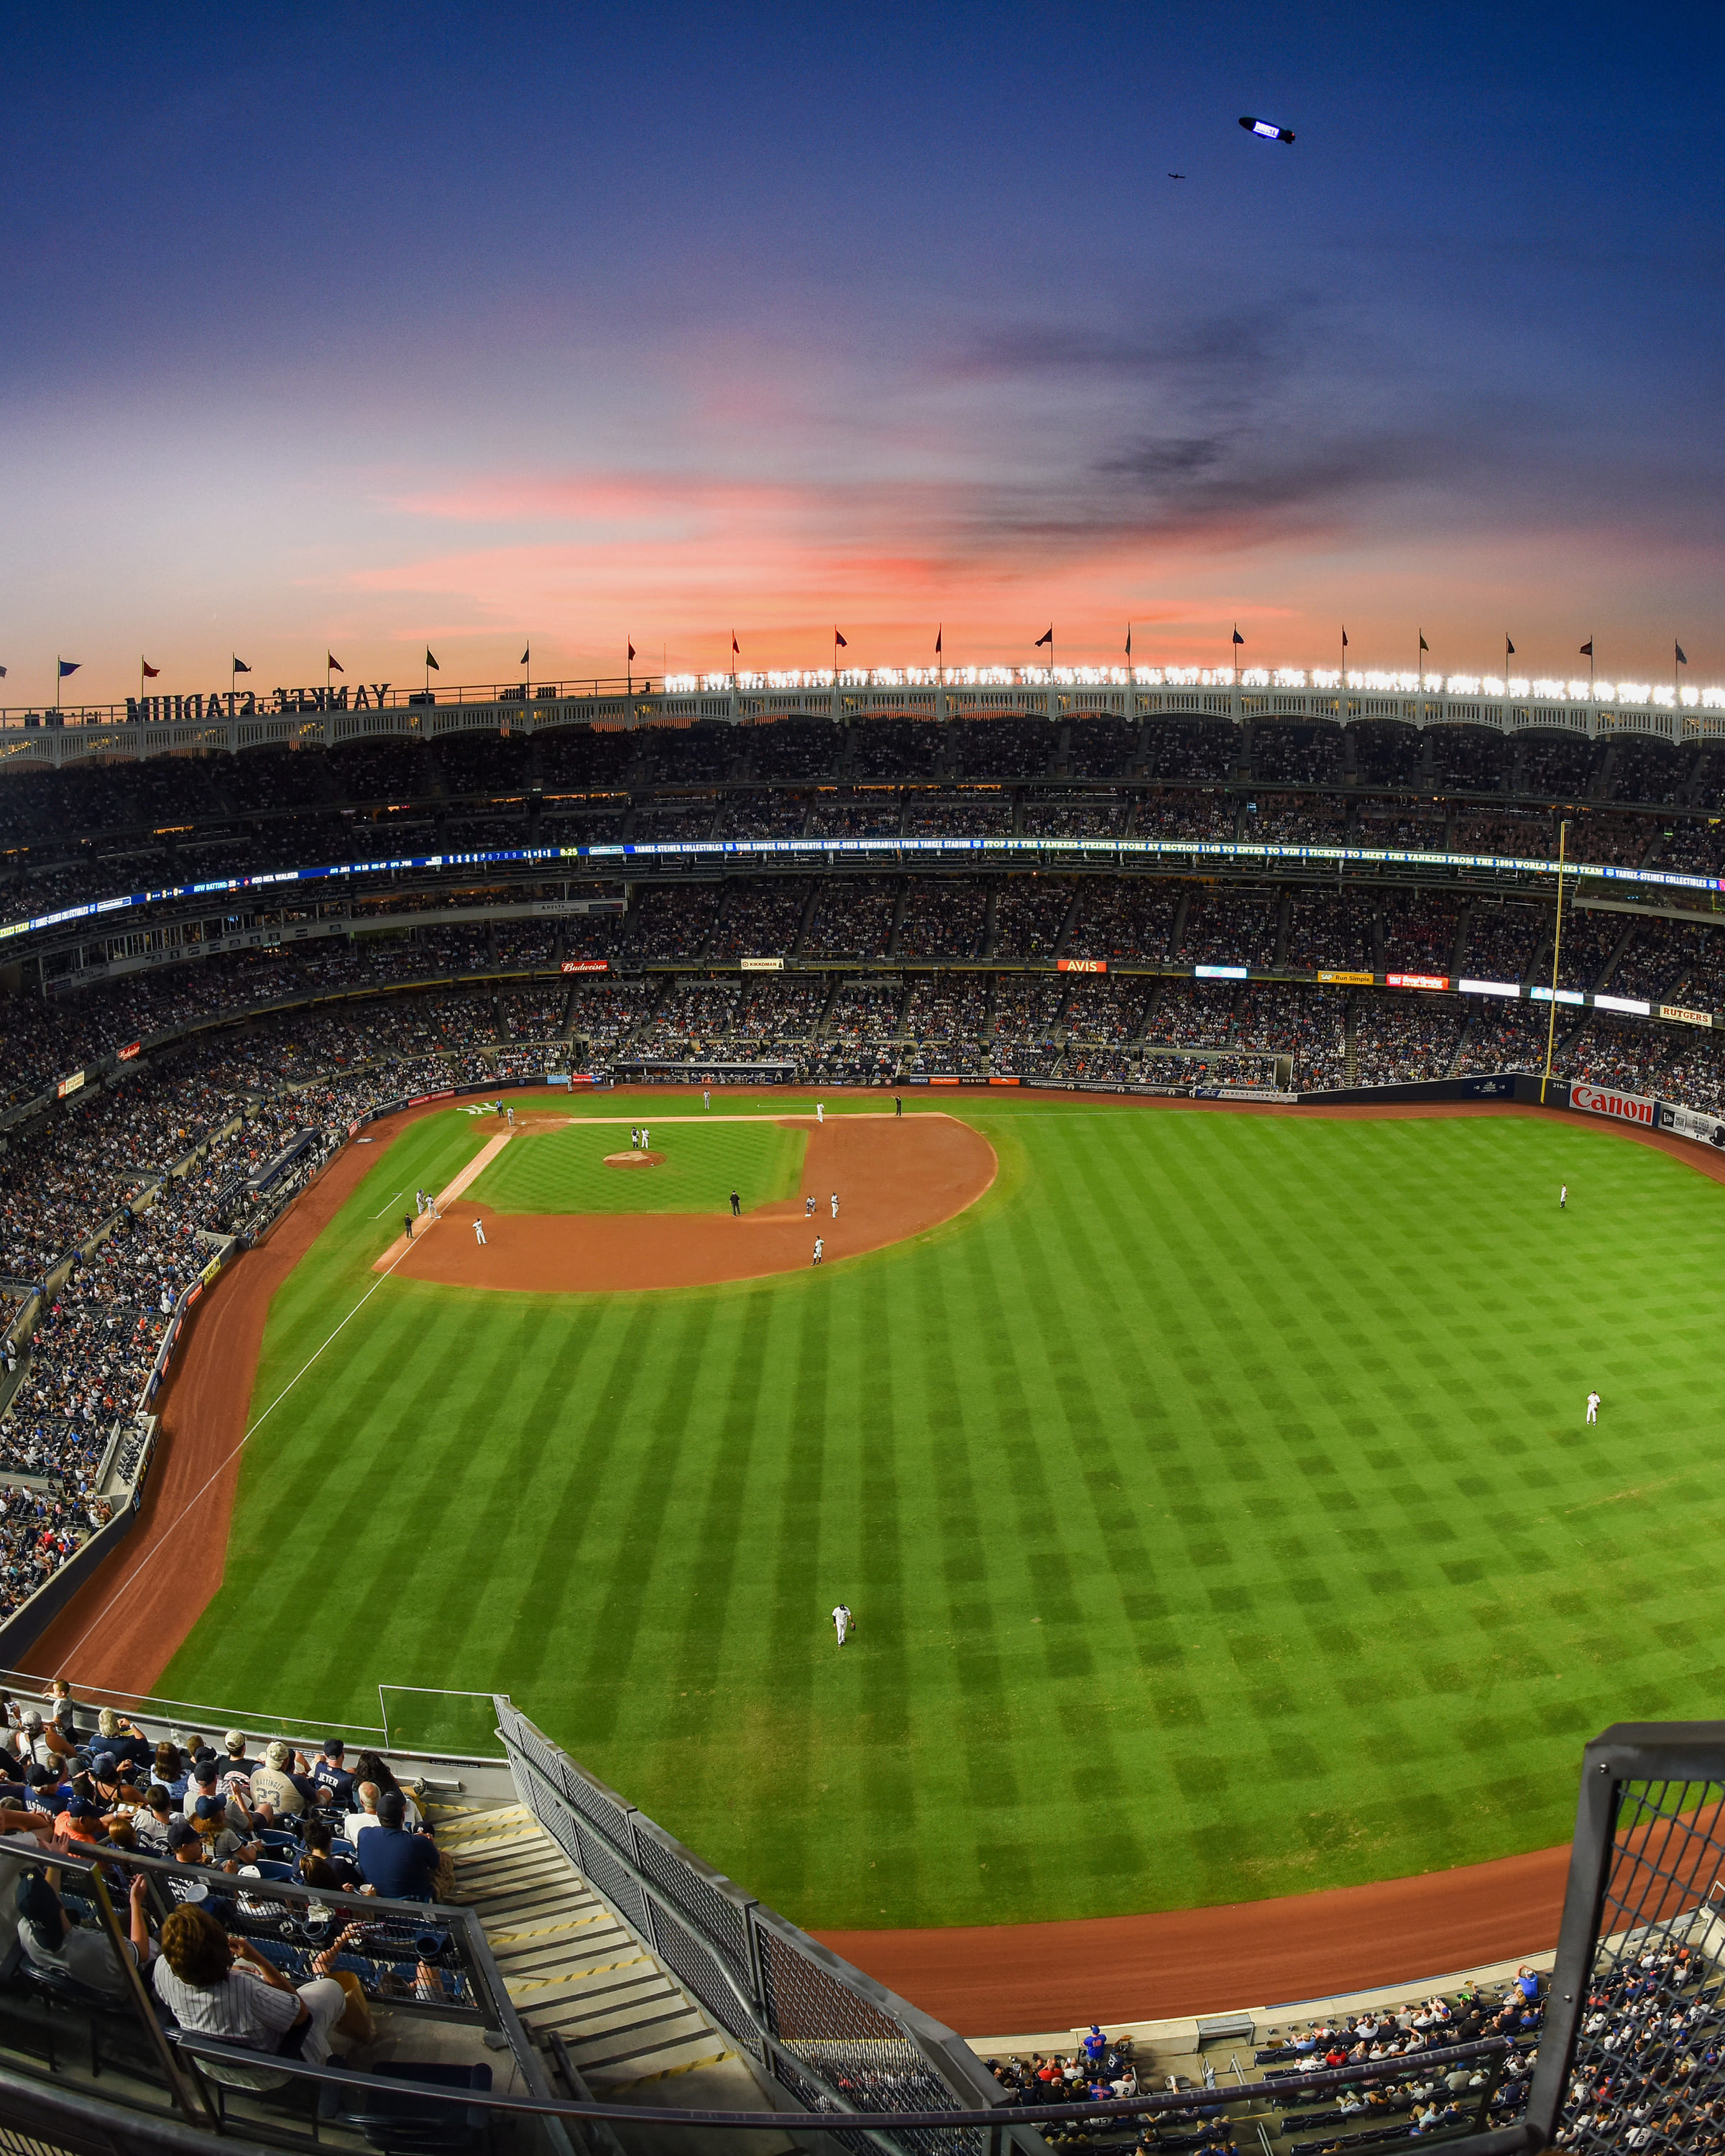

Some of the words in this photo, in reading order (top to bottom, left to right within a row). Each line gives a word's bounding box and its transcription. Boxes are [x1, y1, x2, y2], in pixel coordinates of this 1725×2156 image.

[634, 844, 681, 853] YANKEE-STEINER
[682, 843, 723, 852] COLLECTIBLES
[735, 842, 752, 851] YOUR
[901, 840, 919, 849] FROM
[1039, 841, 1118, 849] YANKEES-STEINER
[1201, 844, 1220, 853] 114B
[1308, 849, 1346, 857] TICKETS
[1407, 853, 1447, 862] YANKEES
[1448, 855, 1474, 864] FROM
[1515, 861, 1547, 870] WORLD
[1549, 864, 1578, 872] SERIES
[1579, 866, 1604, 875] TEAM
[275, 872, 299, 880] WALKER
[1615, 870, 1665, 883] YANKEE-STEINER
[1665, 876, 1707, 888] COLLECTIBLES
[561, 962, 607, 972] Budweiser
[1067, 961, 1098, 972] AVIS
[1663, 1008, 1708, 1023] RUTGERS
[1571, 1086, 1652, 1123] Canon
[1692, 1119, 1710, 1129] ON-FIELD
[256, 1777, 284, 1792] MATTINGLY
[318, 1772, 339, 1788] JETER
[256, 1786, 281, 1808] 23
